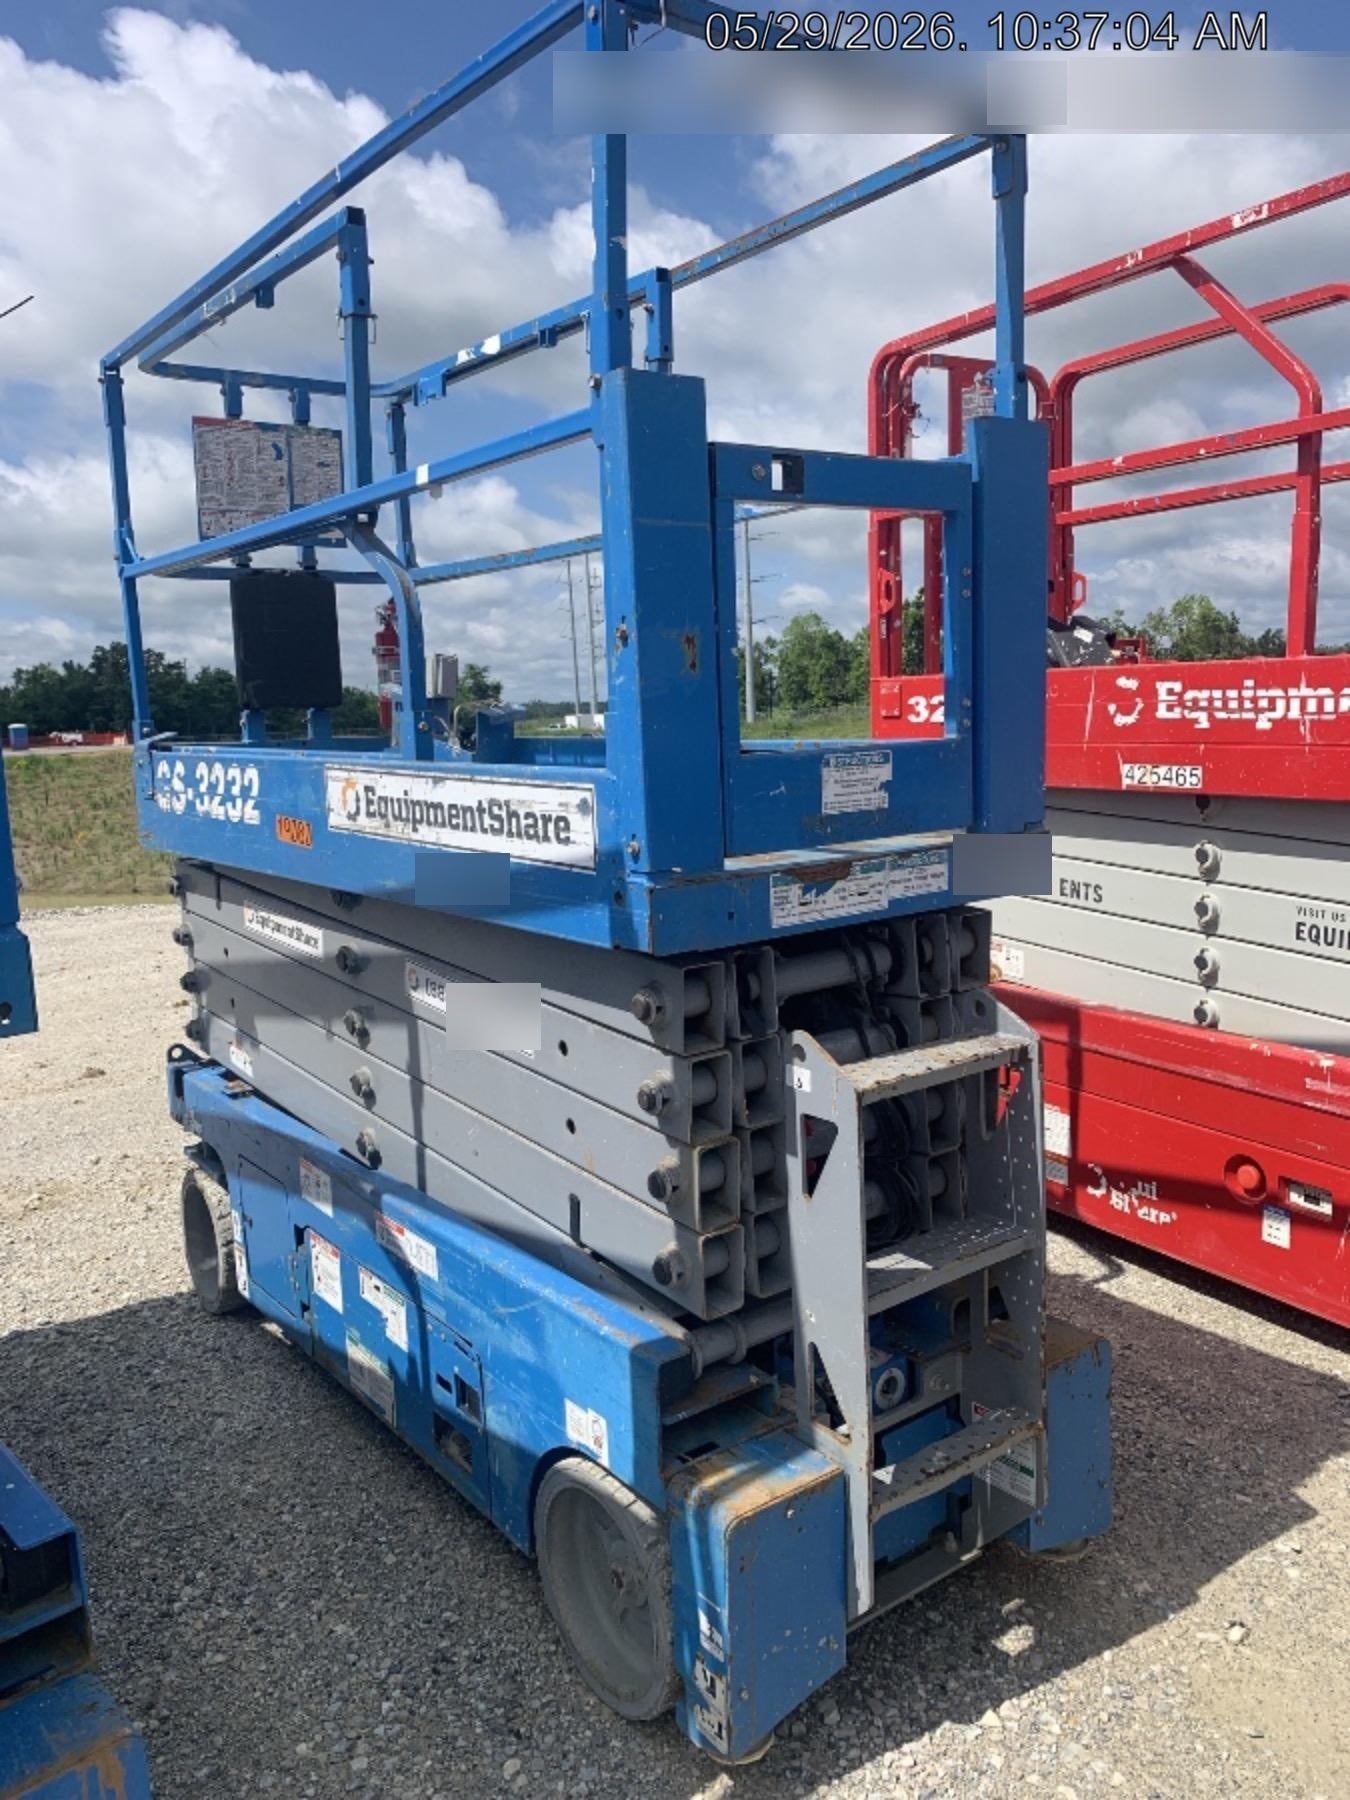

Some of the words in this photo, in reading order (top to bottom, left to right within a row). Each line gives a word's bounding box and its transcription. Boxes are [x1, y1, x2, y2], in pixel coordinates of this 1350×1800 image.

[1125, 764, 1201, 787] 425465
[363, 785, 573, 846] EquipmentShare
[1296, 921, 1350, 950] EQUI
